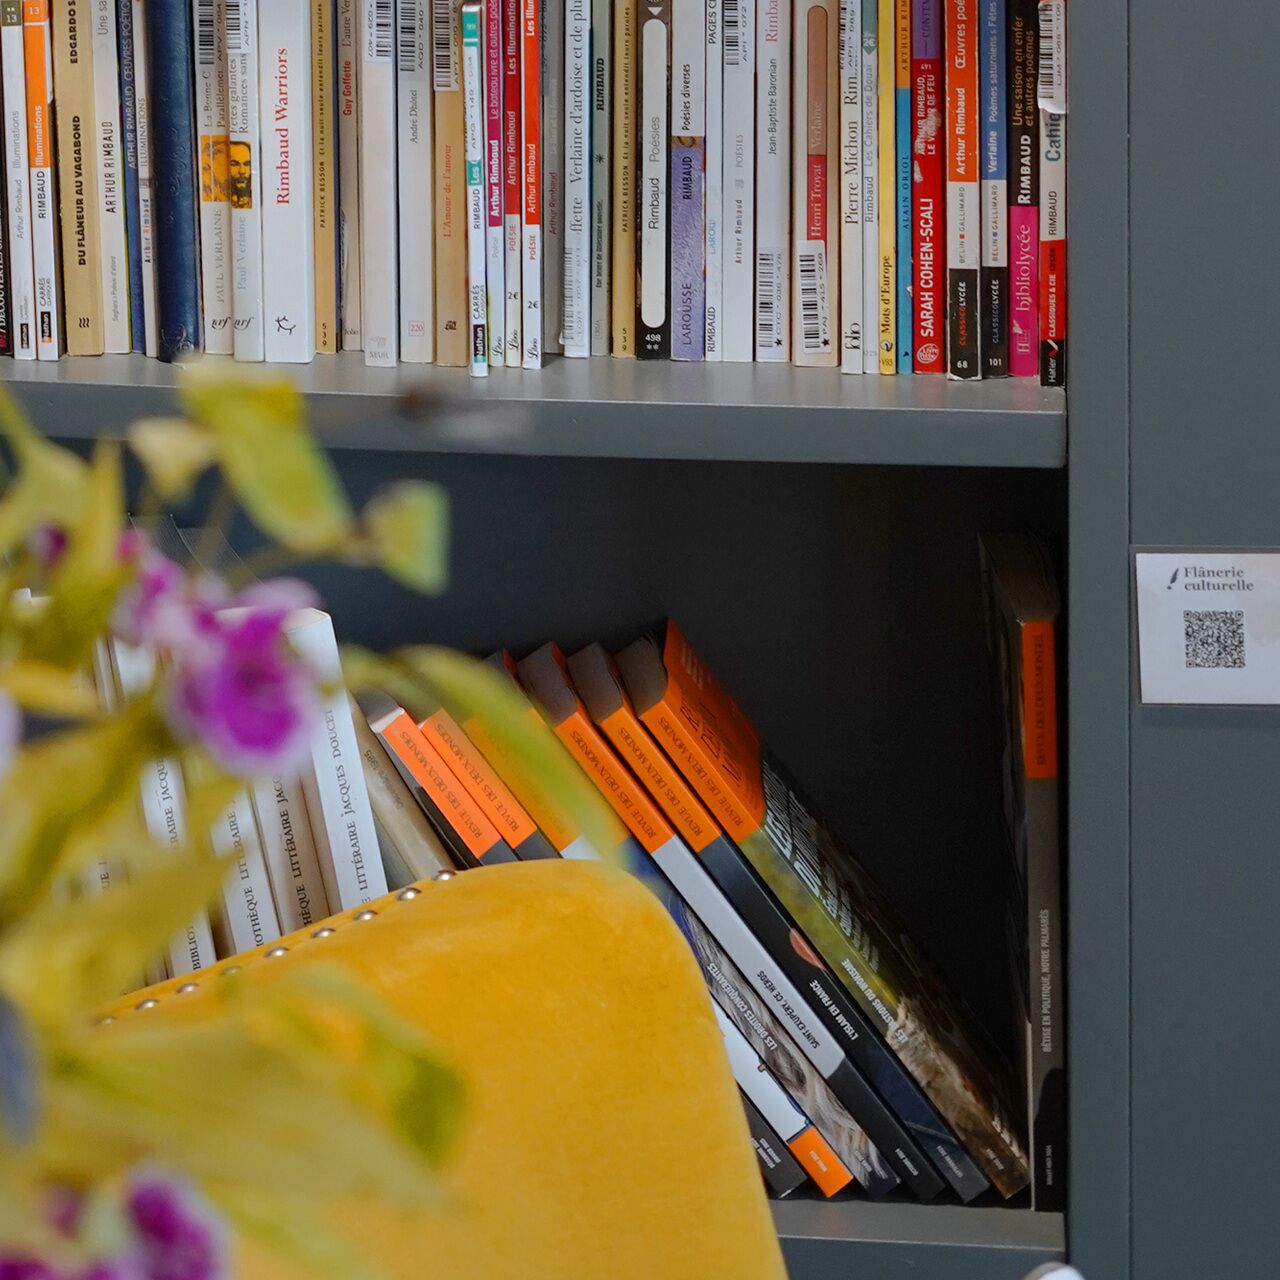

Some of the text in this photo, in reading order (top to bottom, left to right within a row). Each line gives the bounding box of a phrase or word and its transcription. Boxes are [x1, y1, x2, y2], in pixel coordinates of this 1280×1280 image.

[69, 7, 79, 64] EDGARDO
[278, 48, 289, 123] Warriors
[596, 57, 605, 111] RIMBAUD
[769, 58, 777, 97] Baronian
[768, 100, 778, 155] Jean-Baptiste
[955, 87, 965, 134] Rimbaud
[72, 115, 83, 178] VAGABOND
[276, 129, 291, 205] Rimbaud
[845, 120, 858, 225] Pierre Michon
[955, 138, 966, 175] Arthur
[1018, 134, 1031, 204] RIMBAUD
[74, 182, 84, 197] AU
[491, 139, 501, 218] Arthur Rimbaud
[75, 199, 86, 248] FLÂNEUR
[78, 251, 86, 265] DU
[921, 198, 933, 338] SARAH COHEN-SCALI
[1015, 224, 1031, 312] bibliolycée
[683, 282, 692, 344] LAROUSSE
[1184, 566, 1244, 578] Flânerie
[1184, 579, 1254, 591] culturelle
[326, 709, 369, 891] LITTÉRAIRE JACQUES DOUCET
[809, 979, 859, 1040] L'ISLAM EN FRANCE
